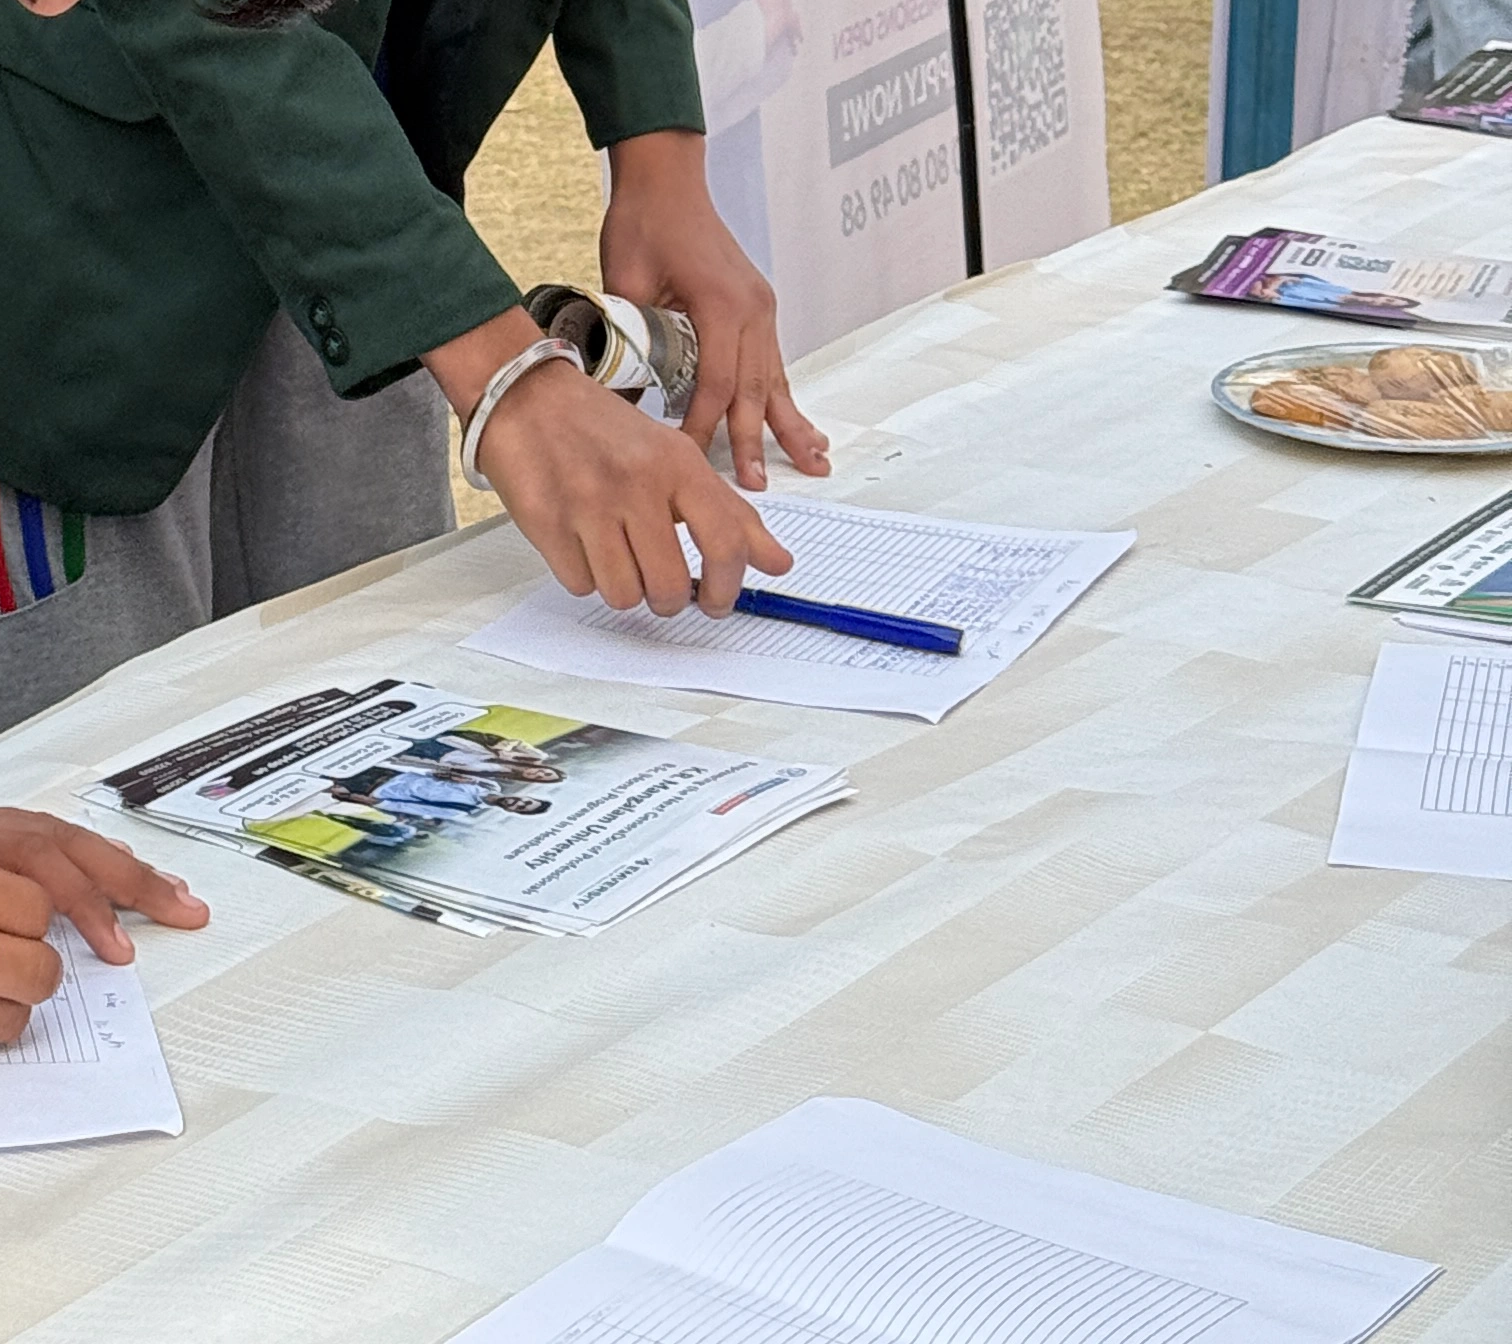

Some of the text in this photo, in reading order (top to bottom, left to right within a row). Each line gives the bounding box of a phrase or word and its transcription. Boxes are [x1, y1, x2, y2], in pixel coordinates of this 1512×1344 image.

[564, 792, 618, 821] Programs
[598, 779, 677, 823] Mangalam
[526, 823, 607, 870] University
[573, 864, 638, 909] EMVERSITY
